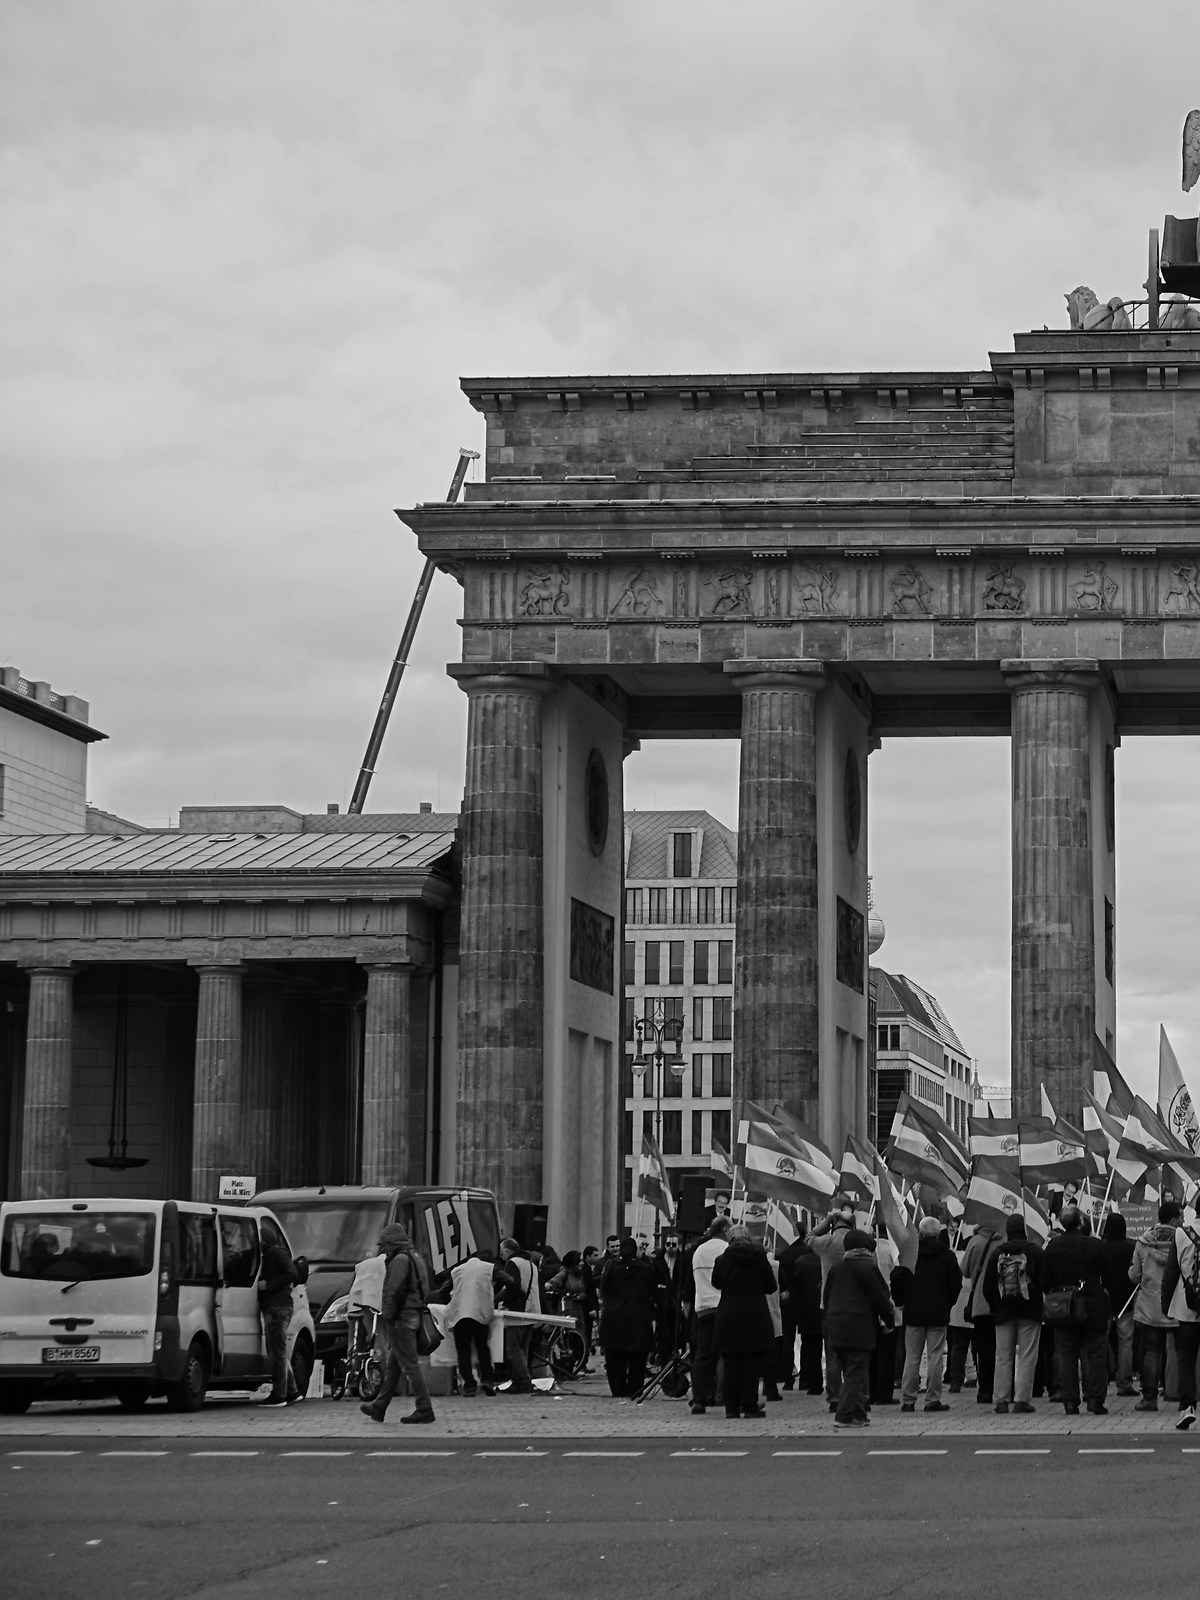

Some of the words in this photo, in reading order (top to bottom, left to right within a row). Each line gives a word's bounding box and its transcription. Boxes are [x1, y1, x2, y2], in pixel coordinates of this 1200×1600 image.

[239, 1188, 251, 1196] März
[424, 1190, 478, 1276] LEX
[74, 1348, 98, 1359] 8567
